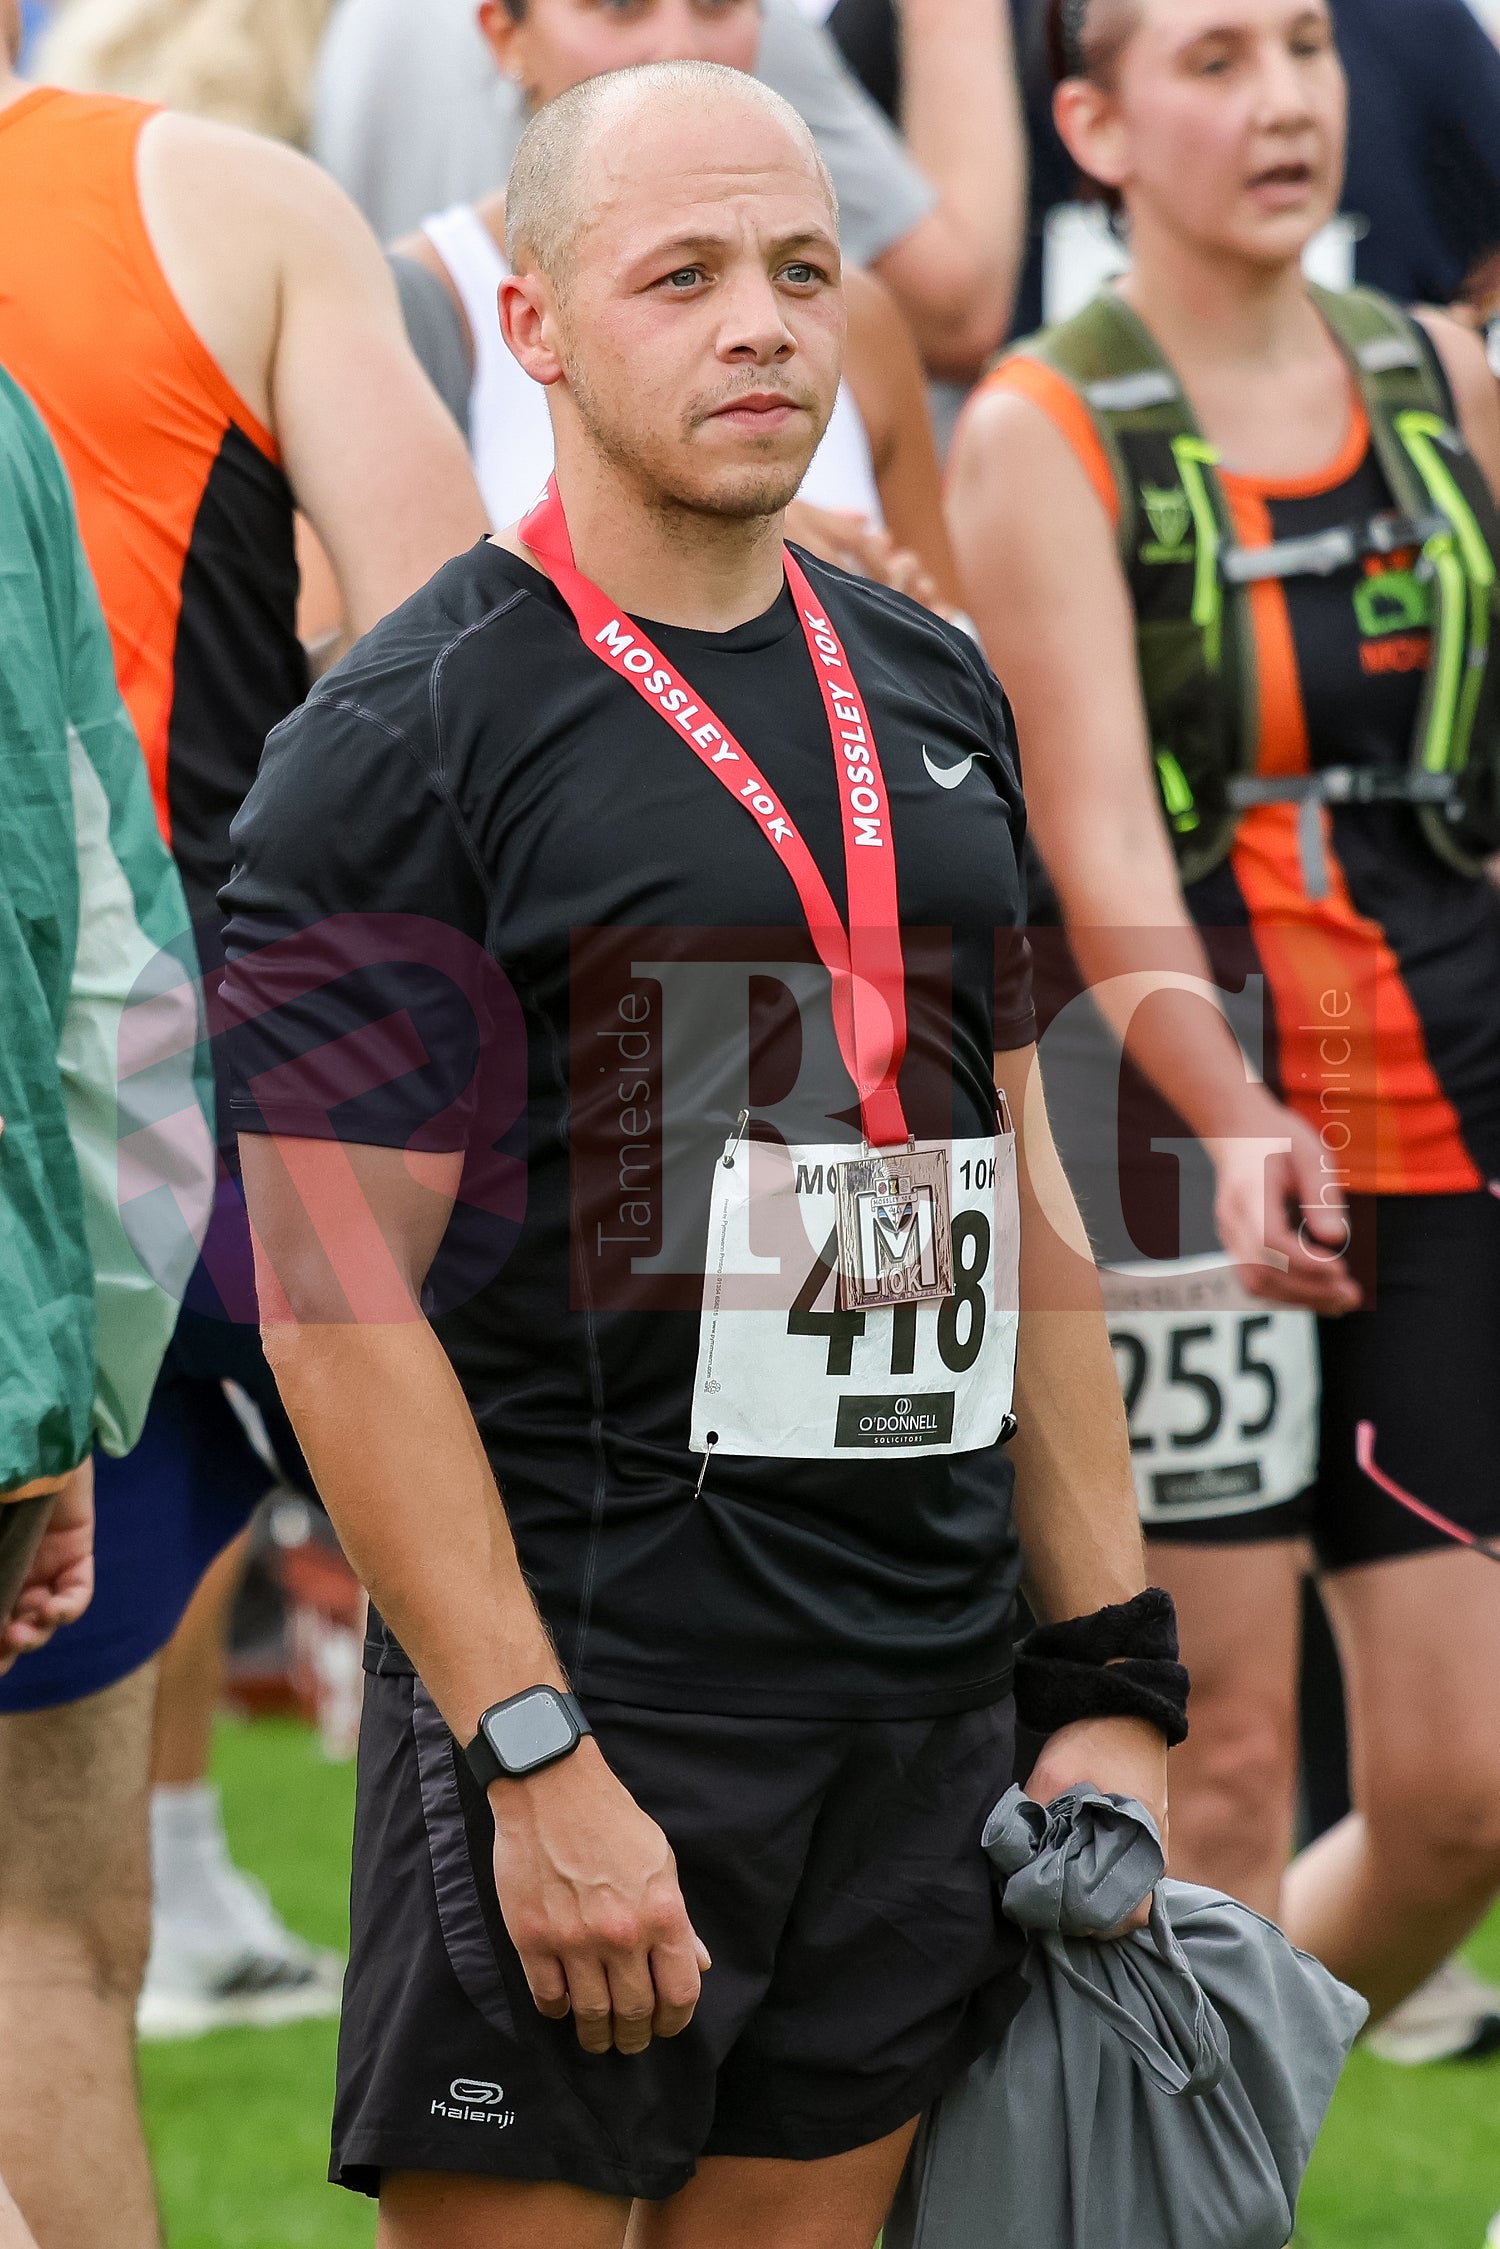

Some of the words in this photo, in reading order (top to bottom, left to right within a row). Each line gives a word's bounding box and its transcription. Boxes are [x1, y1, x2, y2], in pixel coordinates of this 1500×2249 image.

[803, 609, 843, 668] 10K
[594, 618, 740, 766] MOSSLEY
[738, 777, 794, 844] 10K
[827, 680, 883, 847] MOSSLEY
[960, 1157, 998, 1190] 10K
[877, 1264, 923, 1297] 10K
[1110, 1315, 1277, 1448] 255
[859, 1414, 938, 1431] O'DONNELL
[873, 1435, 923, 1444] SOLICITORS
[430, 2099, 515, 2129] Kalenji
